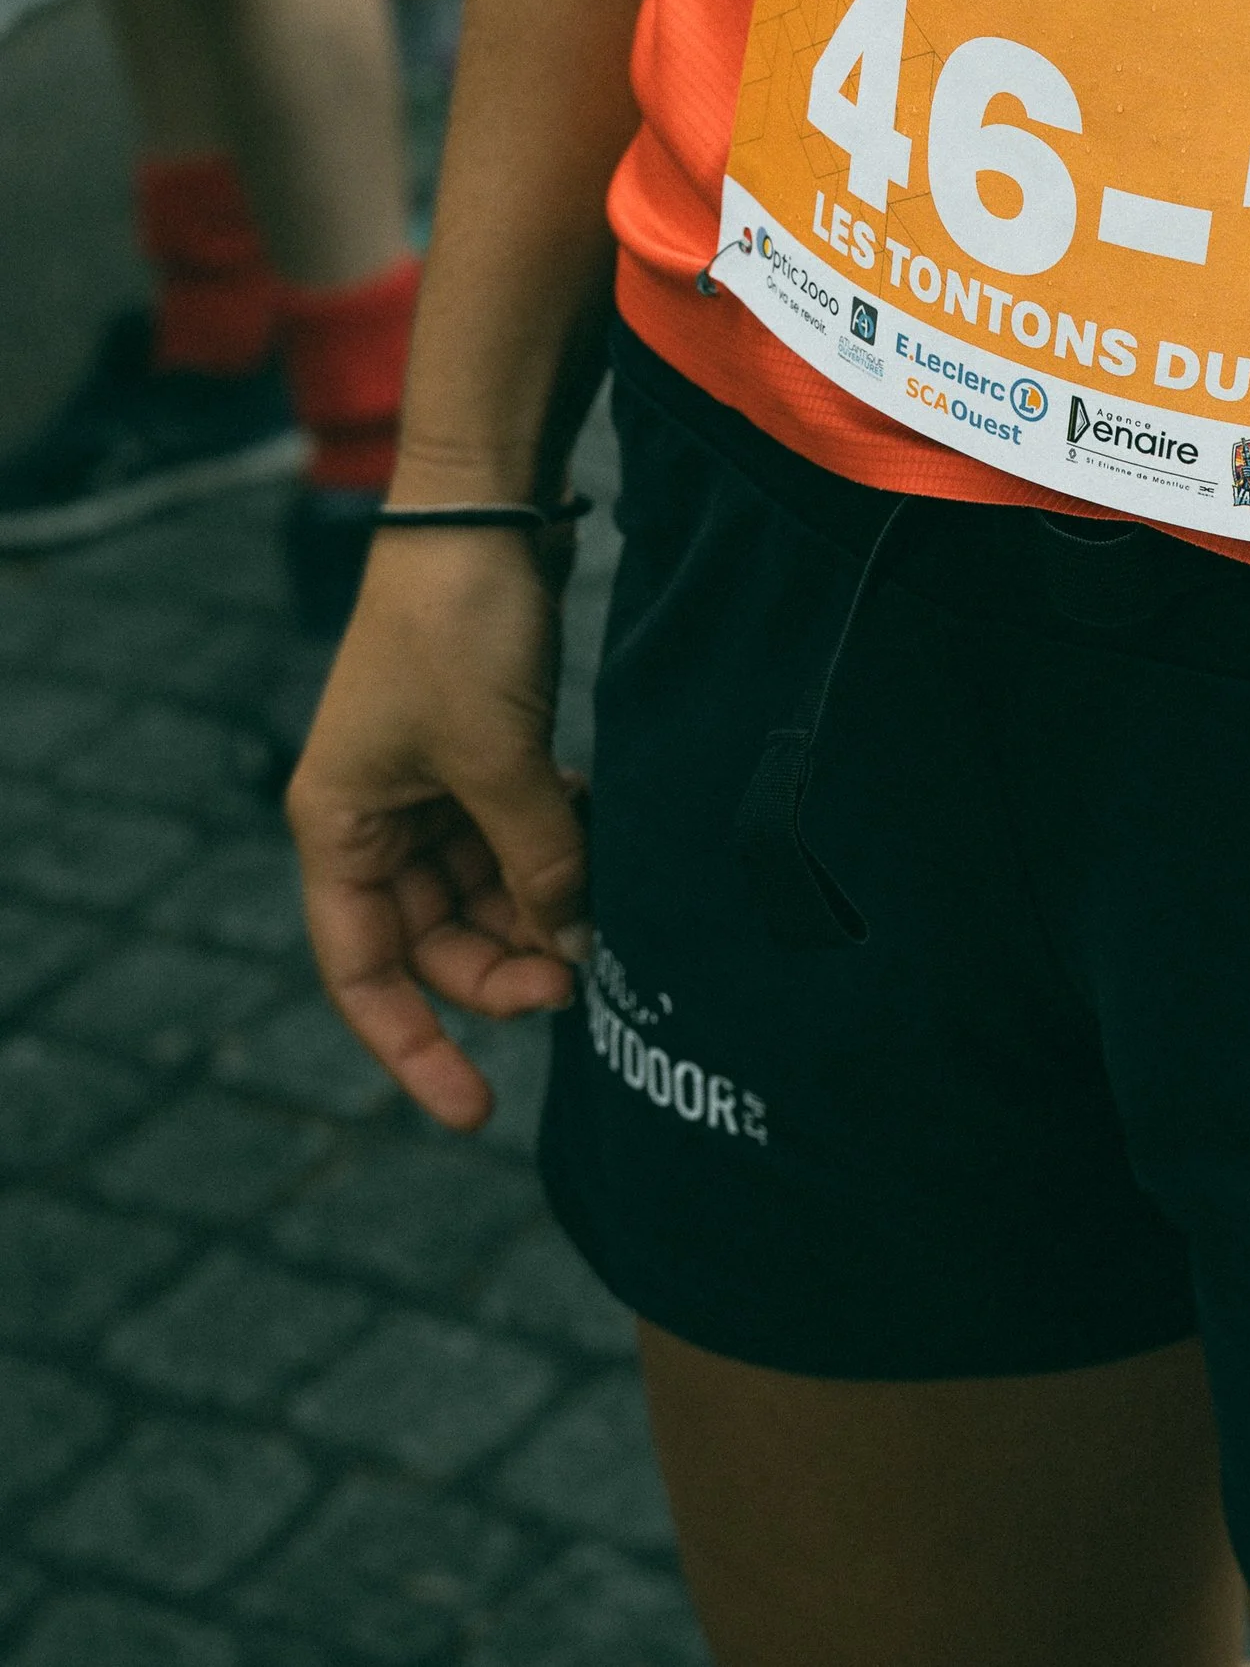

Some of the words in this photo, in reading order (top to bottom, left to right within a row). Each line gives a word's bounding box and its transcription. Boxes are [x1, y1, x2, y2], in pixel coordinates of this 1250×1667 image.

[812, 190, 876, 270] LES
[884, 236, 1138, 377] TONTONS
[896, 332, 1006, 402] E.Leclerc
[1096, 408, 1152, 430] Agence
